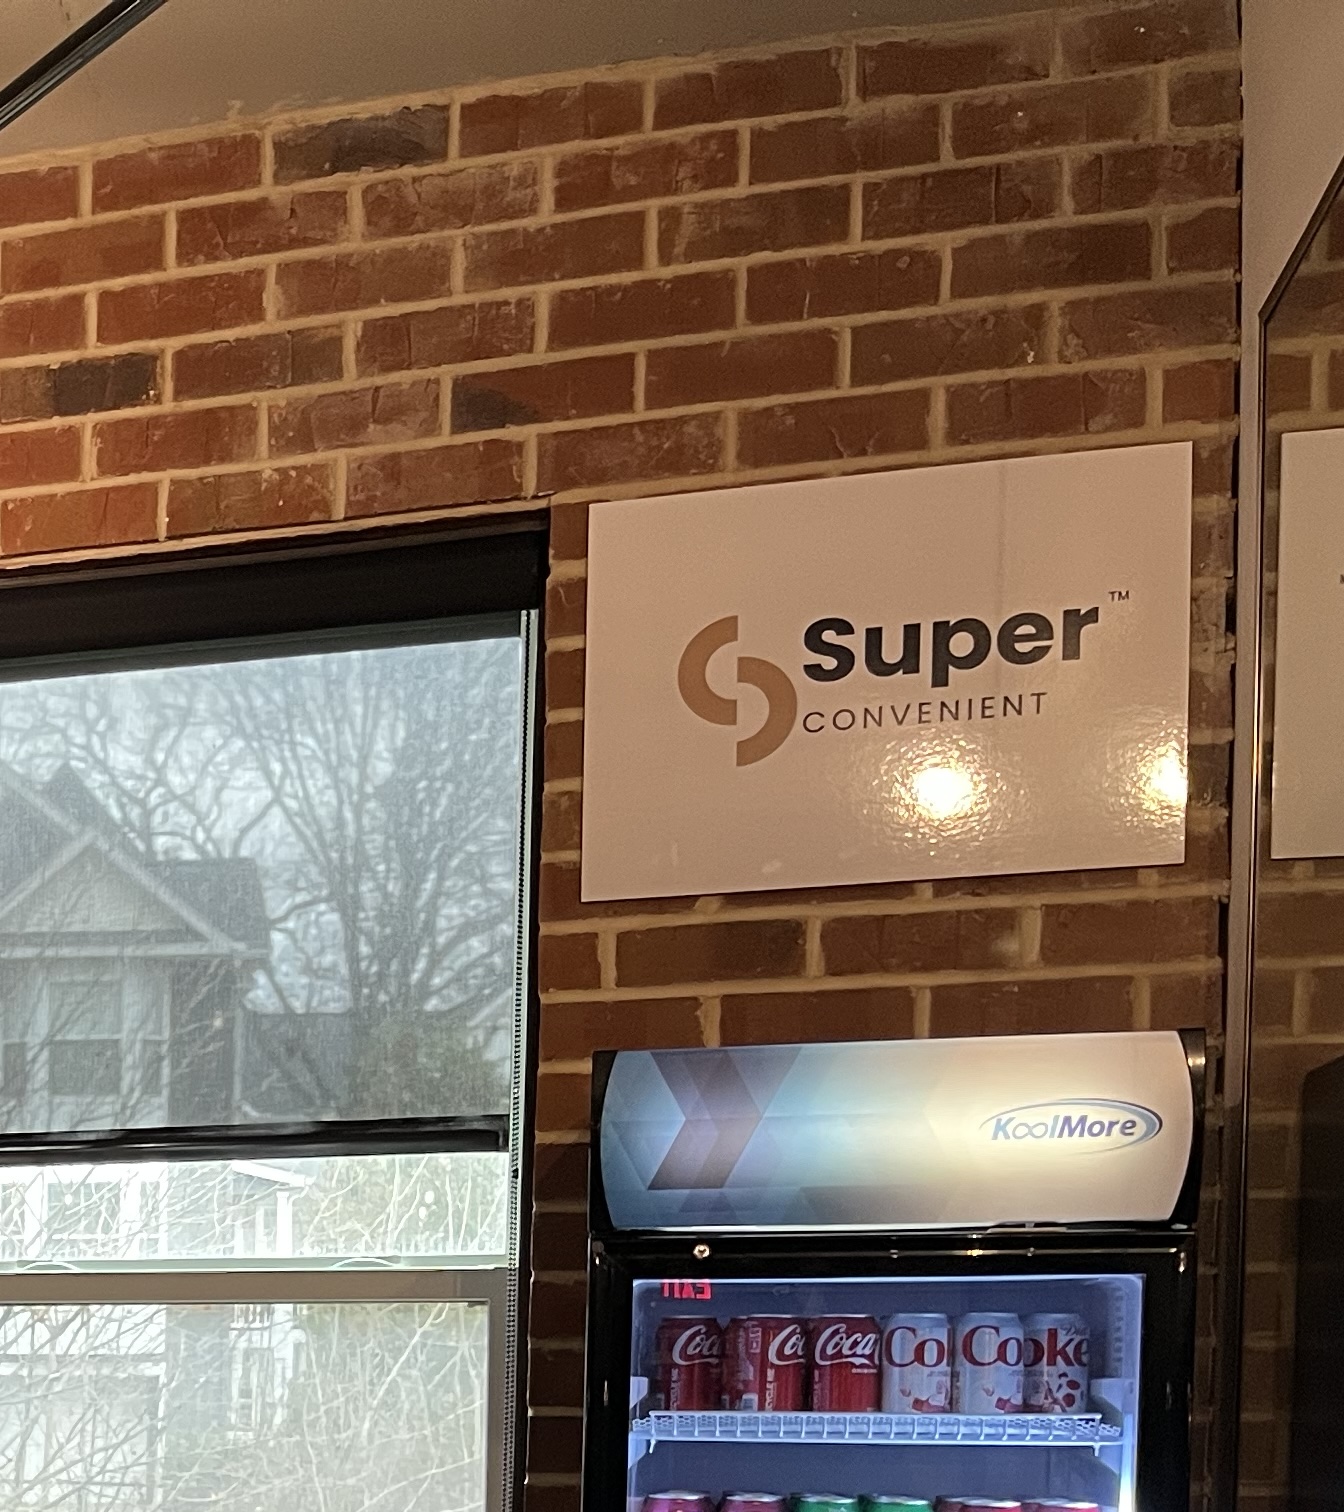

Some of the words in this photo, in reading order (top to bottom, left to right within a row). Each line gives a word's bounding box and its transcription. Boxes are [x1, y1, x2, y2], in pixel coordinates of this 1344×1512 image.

[803, 606, 1099, 687] Super
[1108, 590, 1130, 601] TM
[802, 691, 1048, 733] CONVENIENT
[992, 1115, 1136, 1140] KoolMore
[1024, 1328, 1089, 1367] oke
